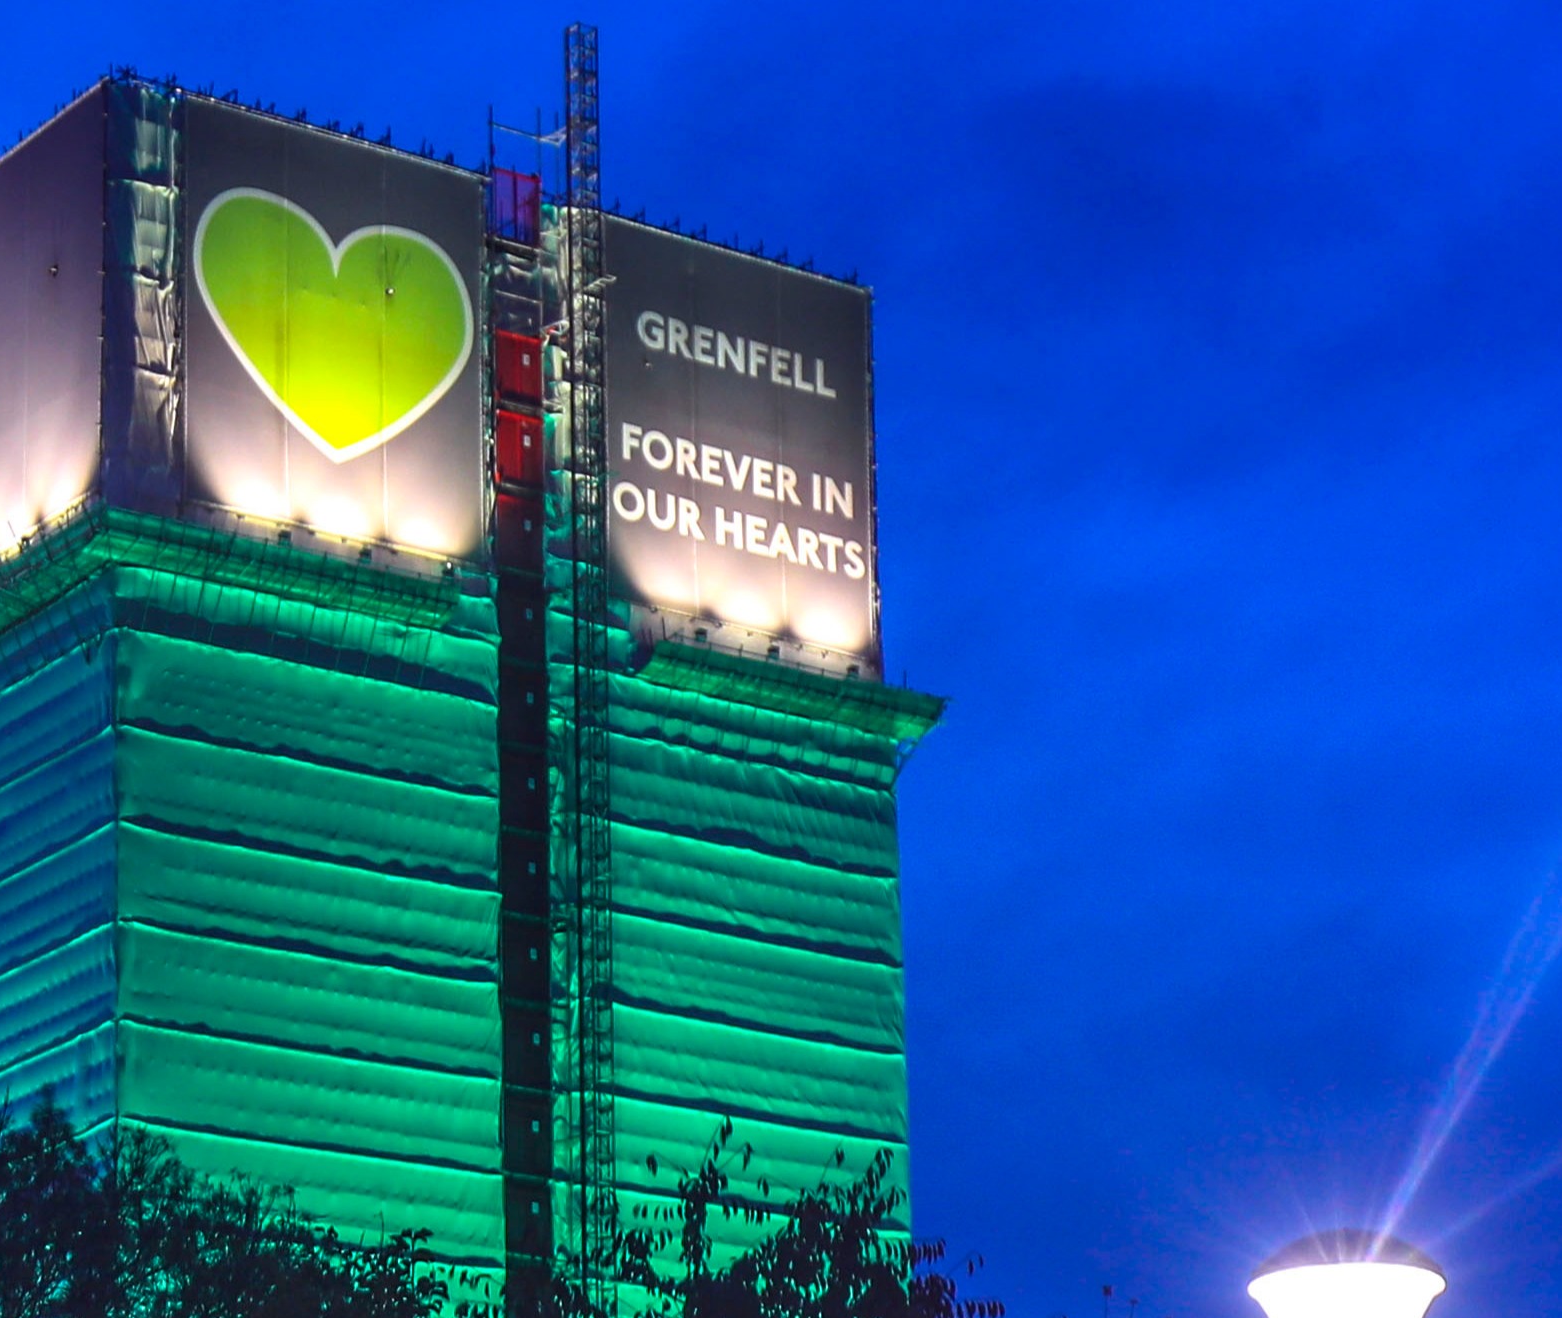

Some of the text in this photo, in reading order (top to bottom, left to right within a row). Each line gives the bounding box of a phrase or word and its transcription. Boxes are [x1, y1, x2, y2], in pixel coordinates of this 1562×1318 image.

[638, 310, 837, 398] GRENFELL
[621, 421, 854, 519] FOREVER IN
[612, 481, 866, 580] OUR HEARTS
